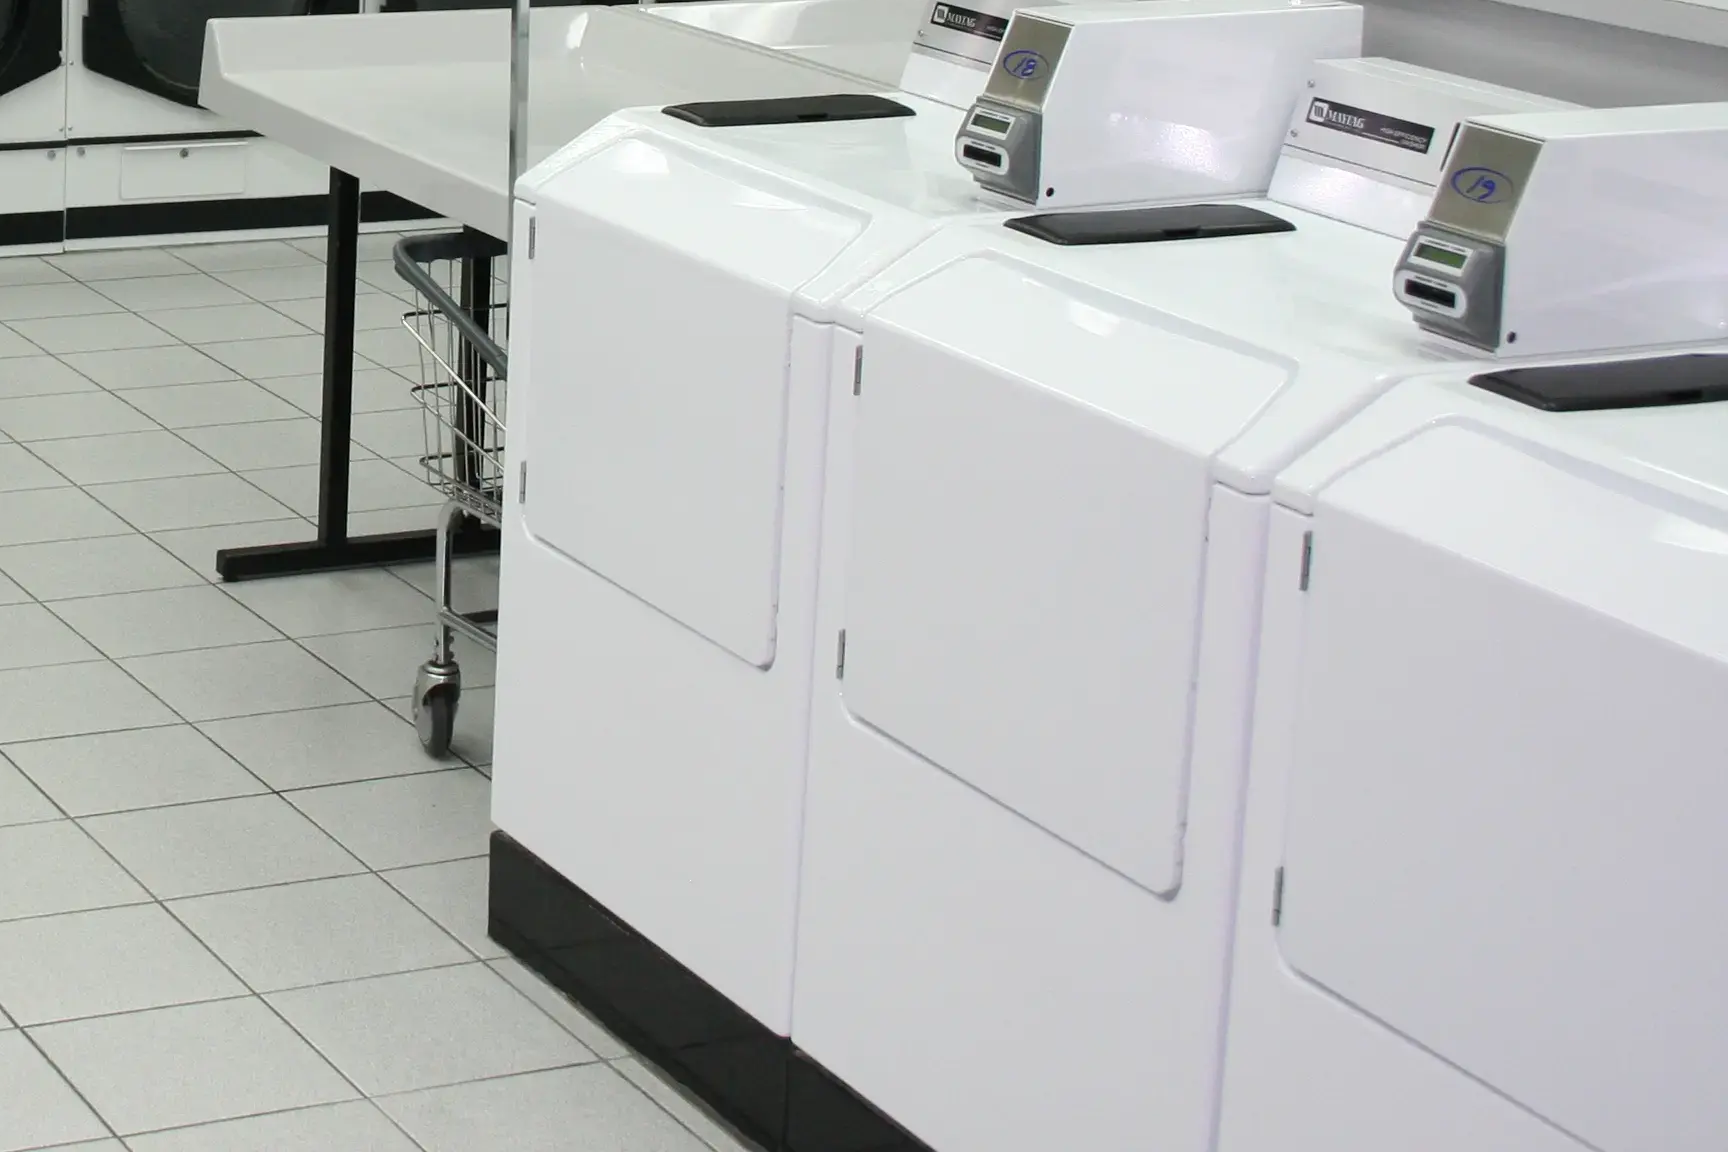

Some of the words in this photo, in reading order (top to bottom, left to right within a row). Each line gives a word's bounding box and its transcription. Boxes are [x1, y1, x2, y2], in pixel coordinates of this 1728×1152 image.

[1013, 56, 1036, 76] 18
[1327, 109, 1366, 129] MAYTAG
[1466, 175, 1495, 200] 19
